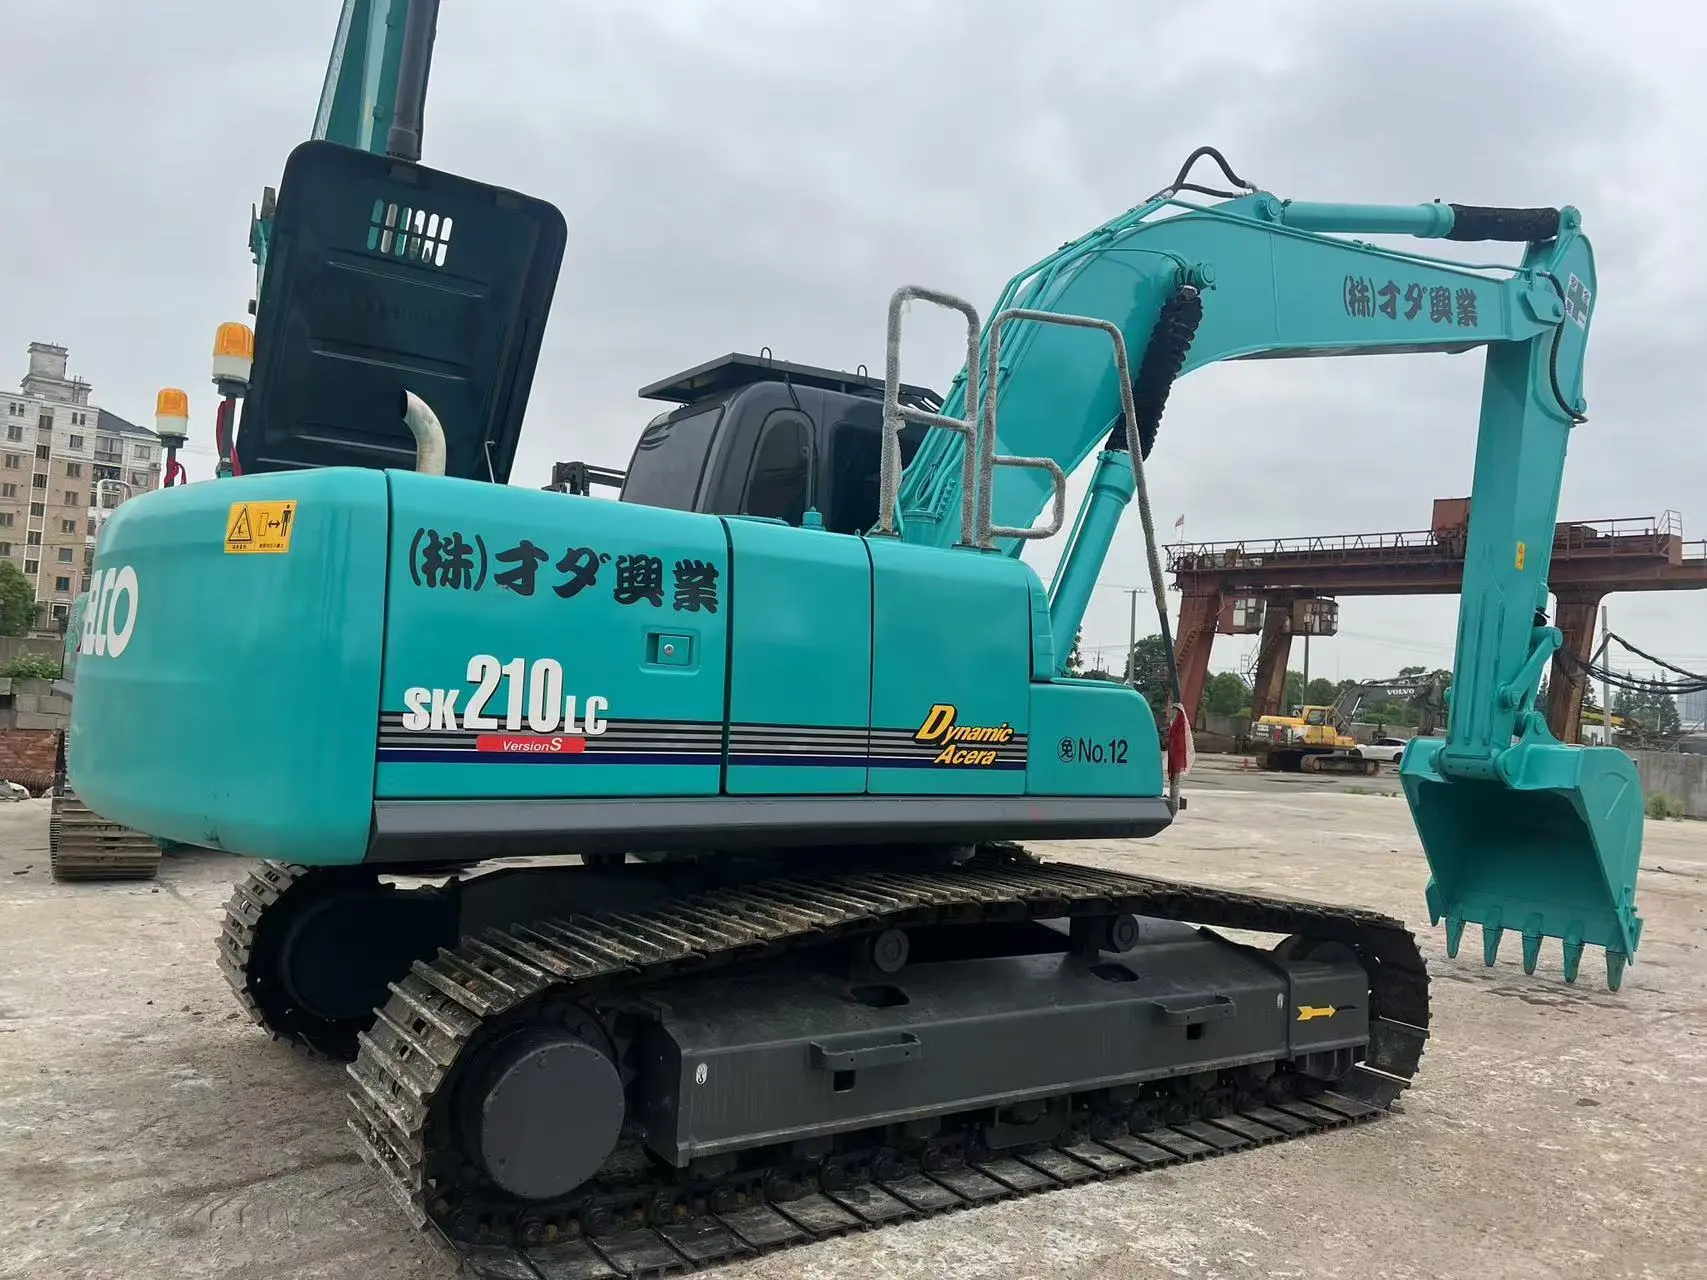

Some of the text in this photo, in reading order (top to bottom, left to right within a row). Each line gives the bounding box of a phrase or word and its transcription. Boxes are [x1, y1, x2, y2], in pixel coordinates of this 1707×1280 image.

[409, 527, 720, 614] (株)オダ興業
[1387, 688, 1415, 696] VOLVO
[914, 704, 1014, 745] Dynamic
[934, 744, 998, 765] Acera
[1078, 737, 1128, 764] No.12
